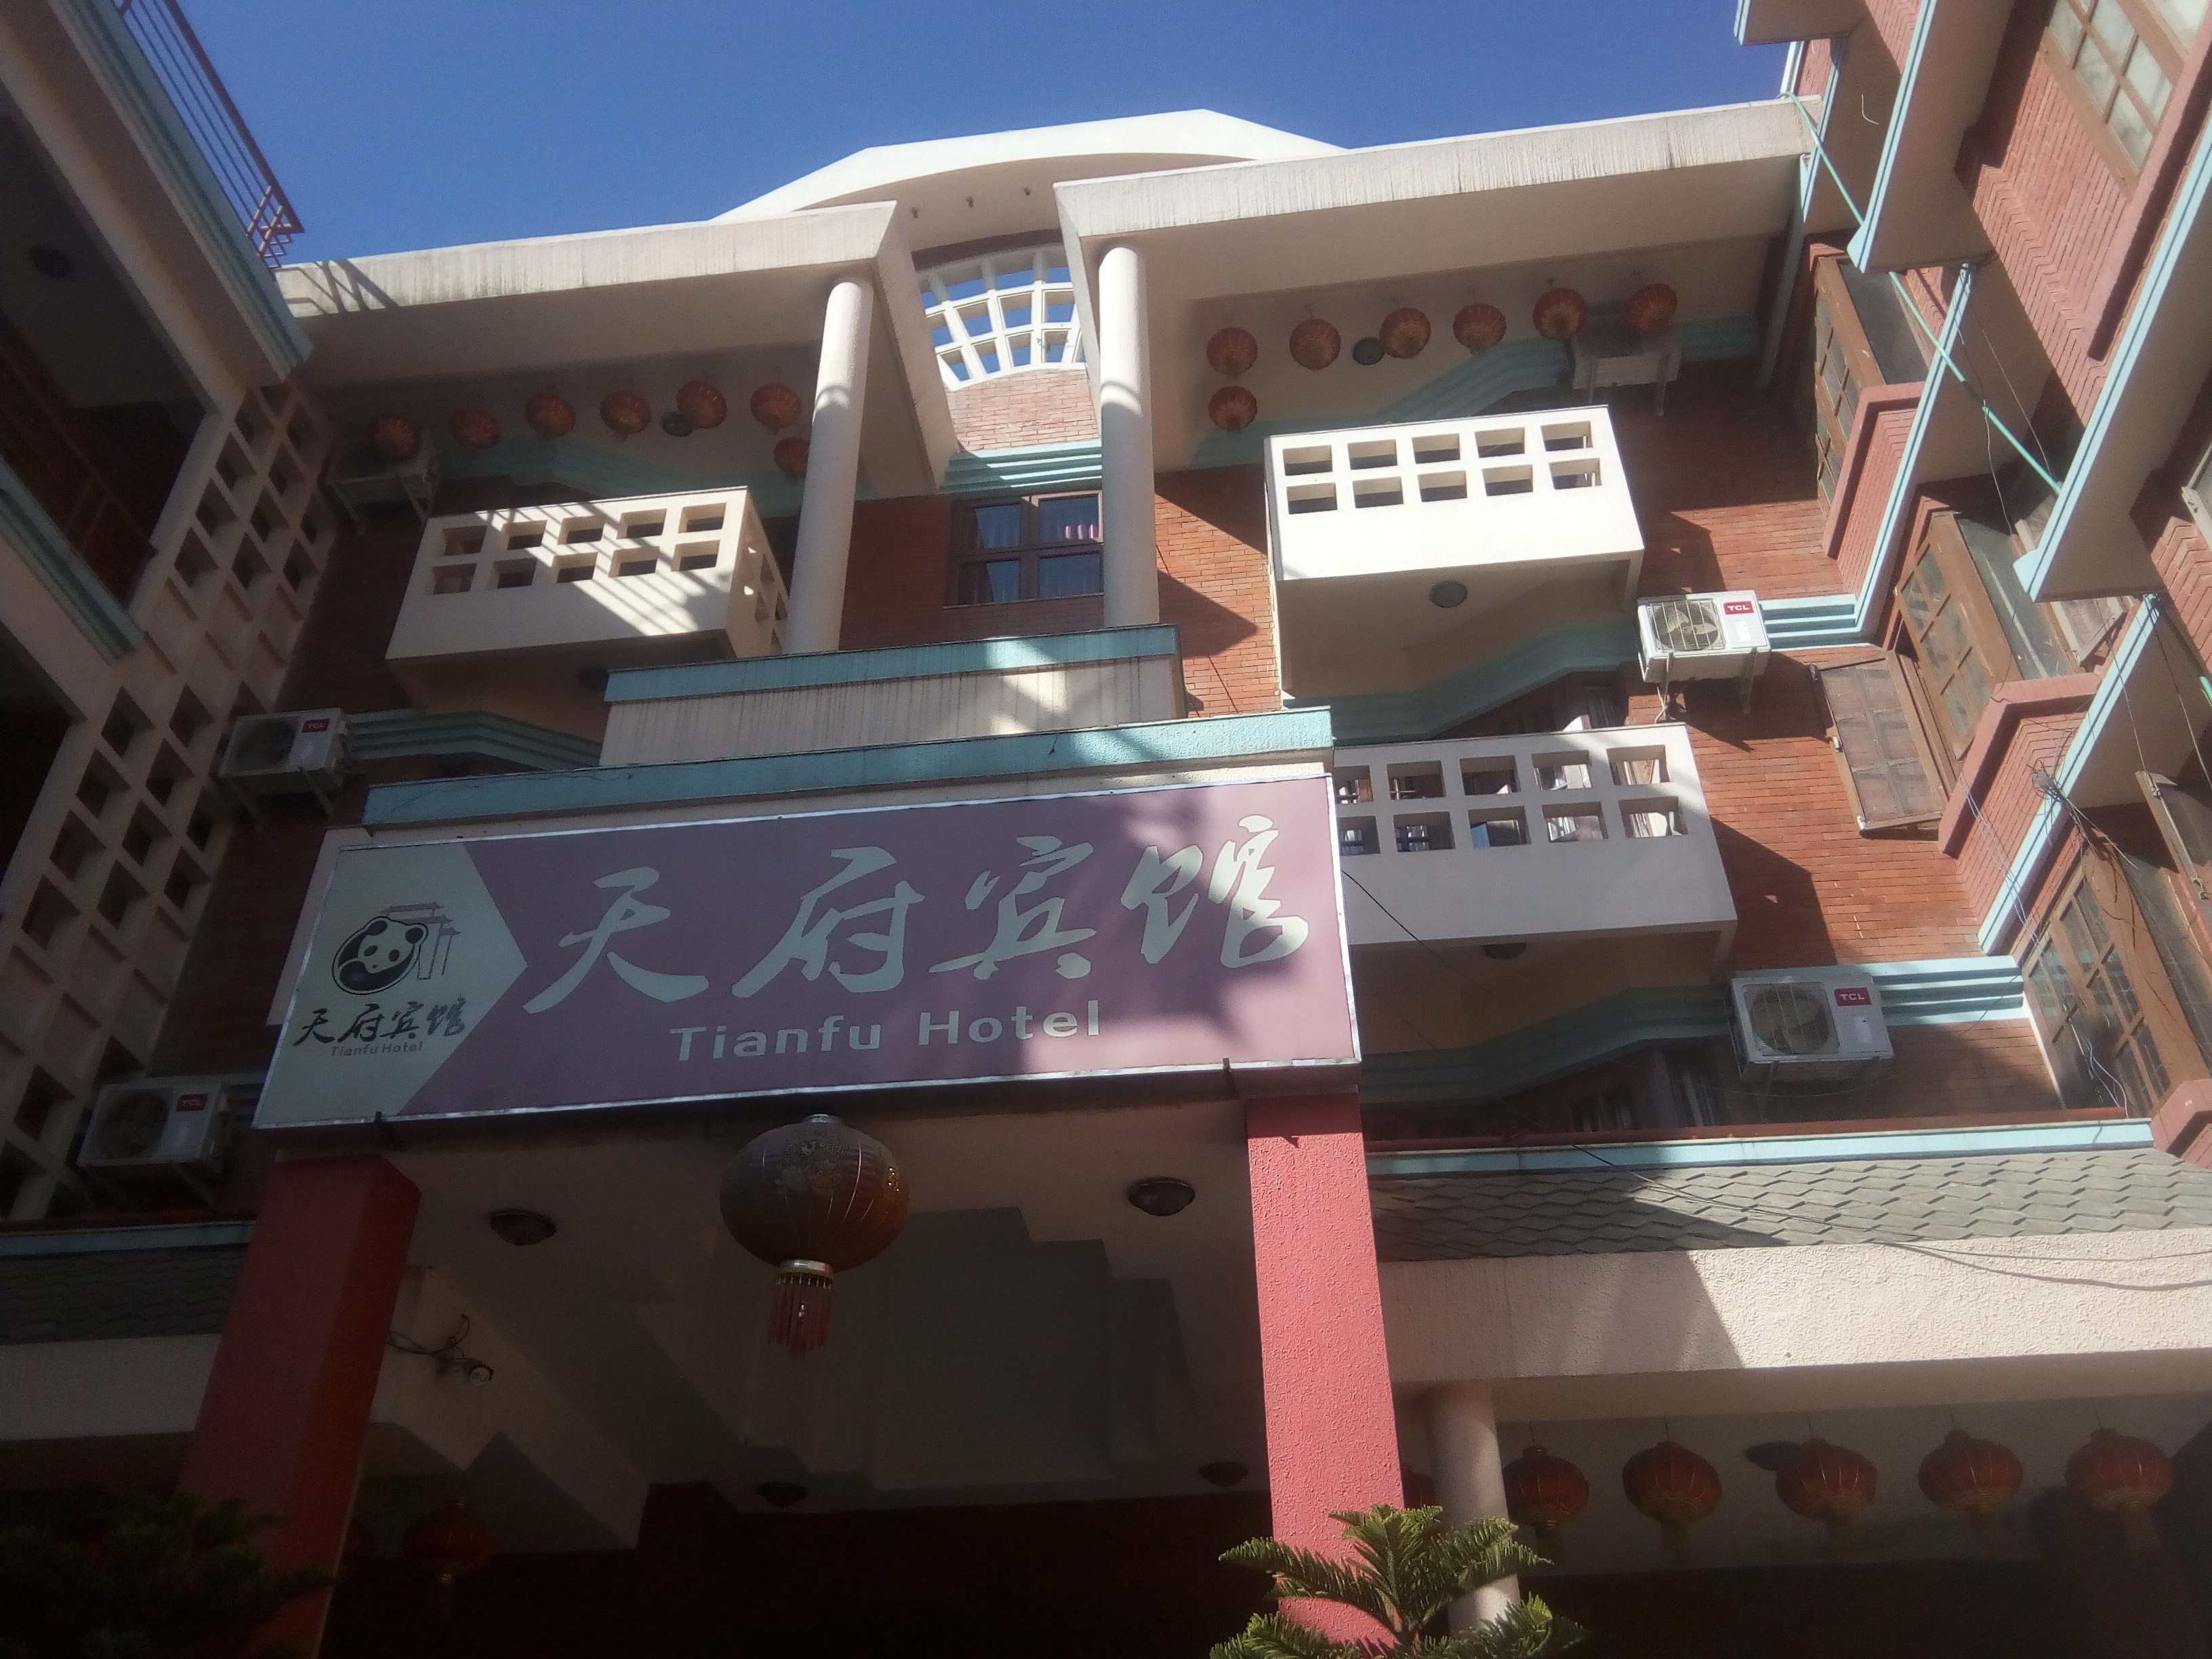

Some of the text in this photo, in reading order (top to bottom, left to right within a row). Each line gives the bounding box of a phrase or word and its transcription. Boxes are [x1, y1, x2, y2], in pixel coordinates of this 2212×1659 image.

[523, 815, 1309, 1013] 天府宾馆
[293, 995, 466, 1046] 天府宾馆
[1839, 993, 1865, 1001] TCL
[331, 1041, 423, 1056] Tianfu Hotel
[670, 1000, 1101, 1061] Tianfu Hotel
